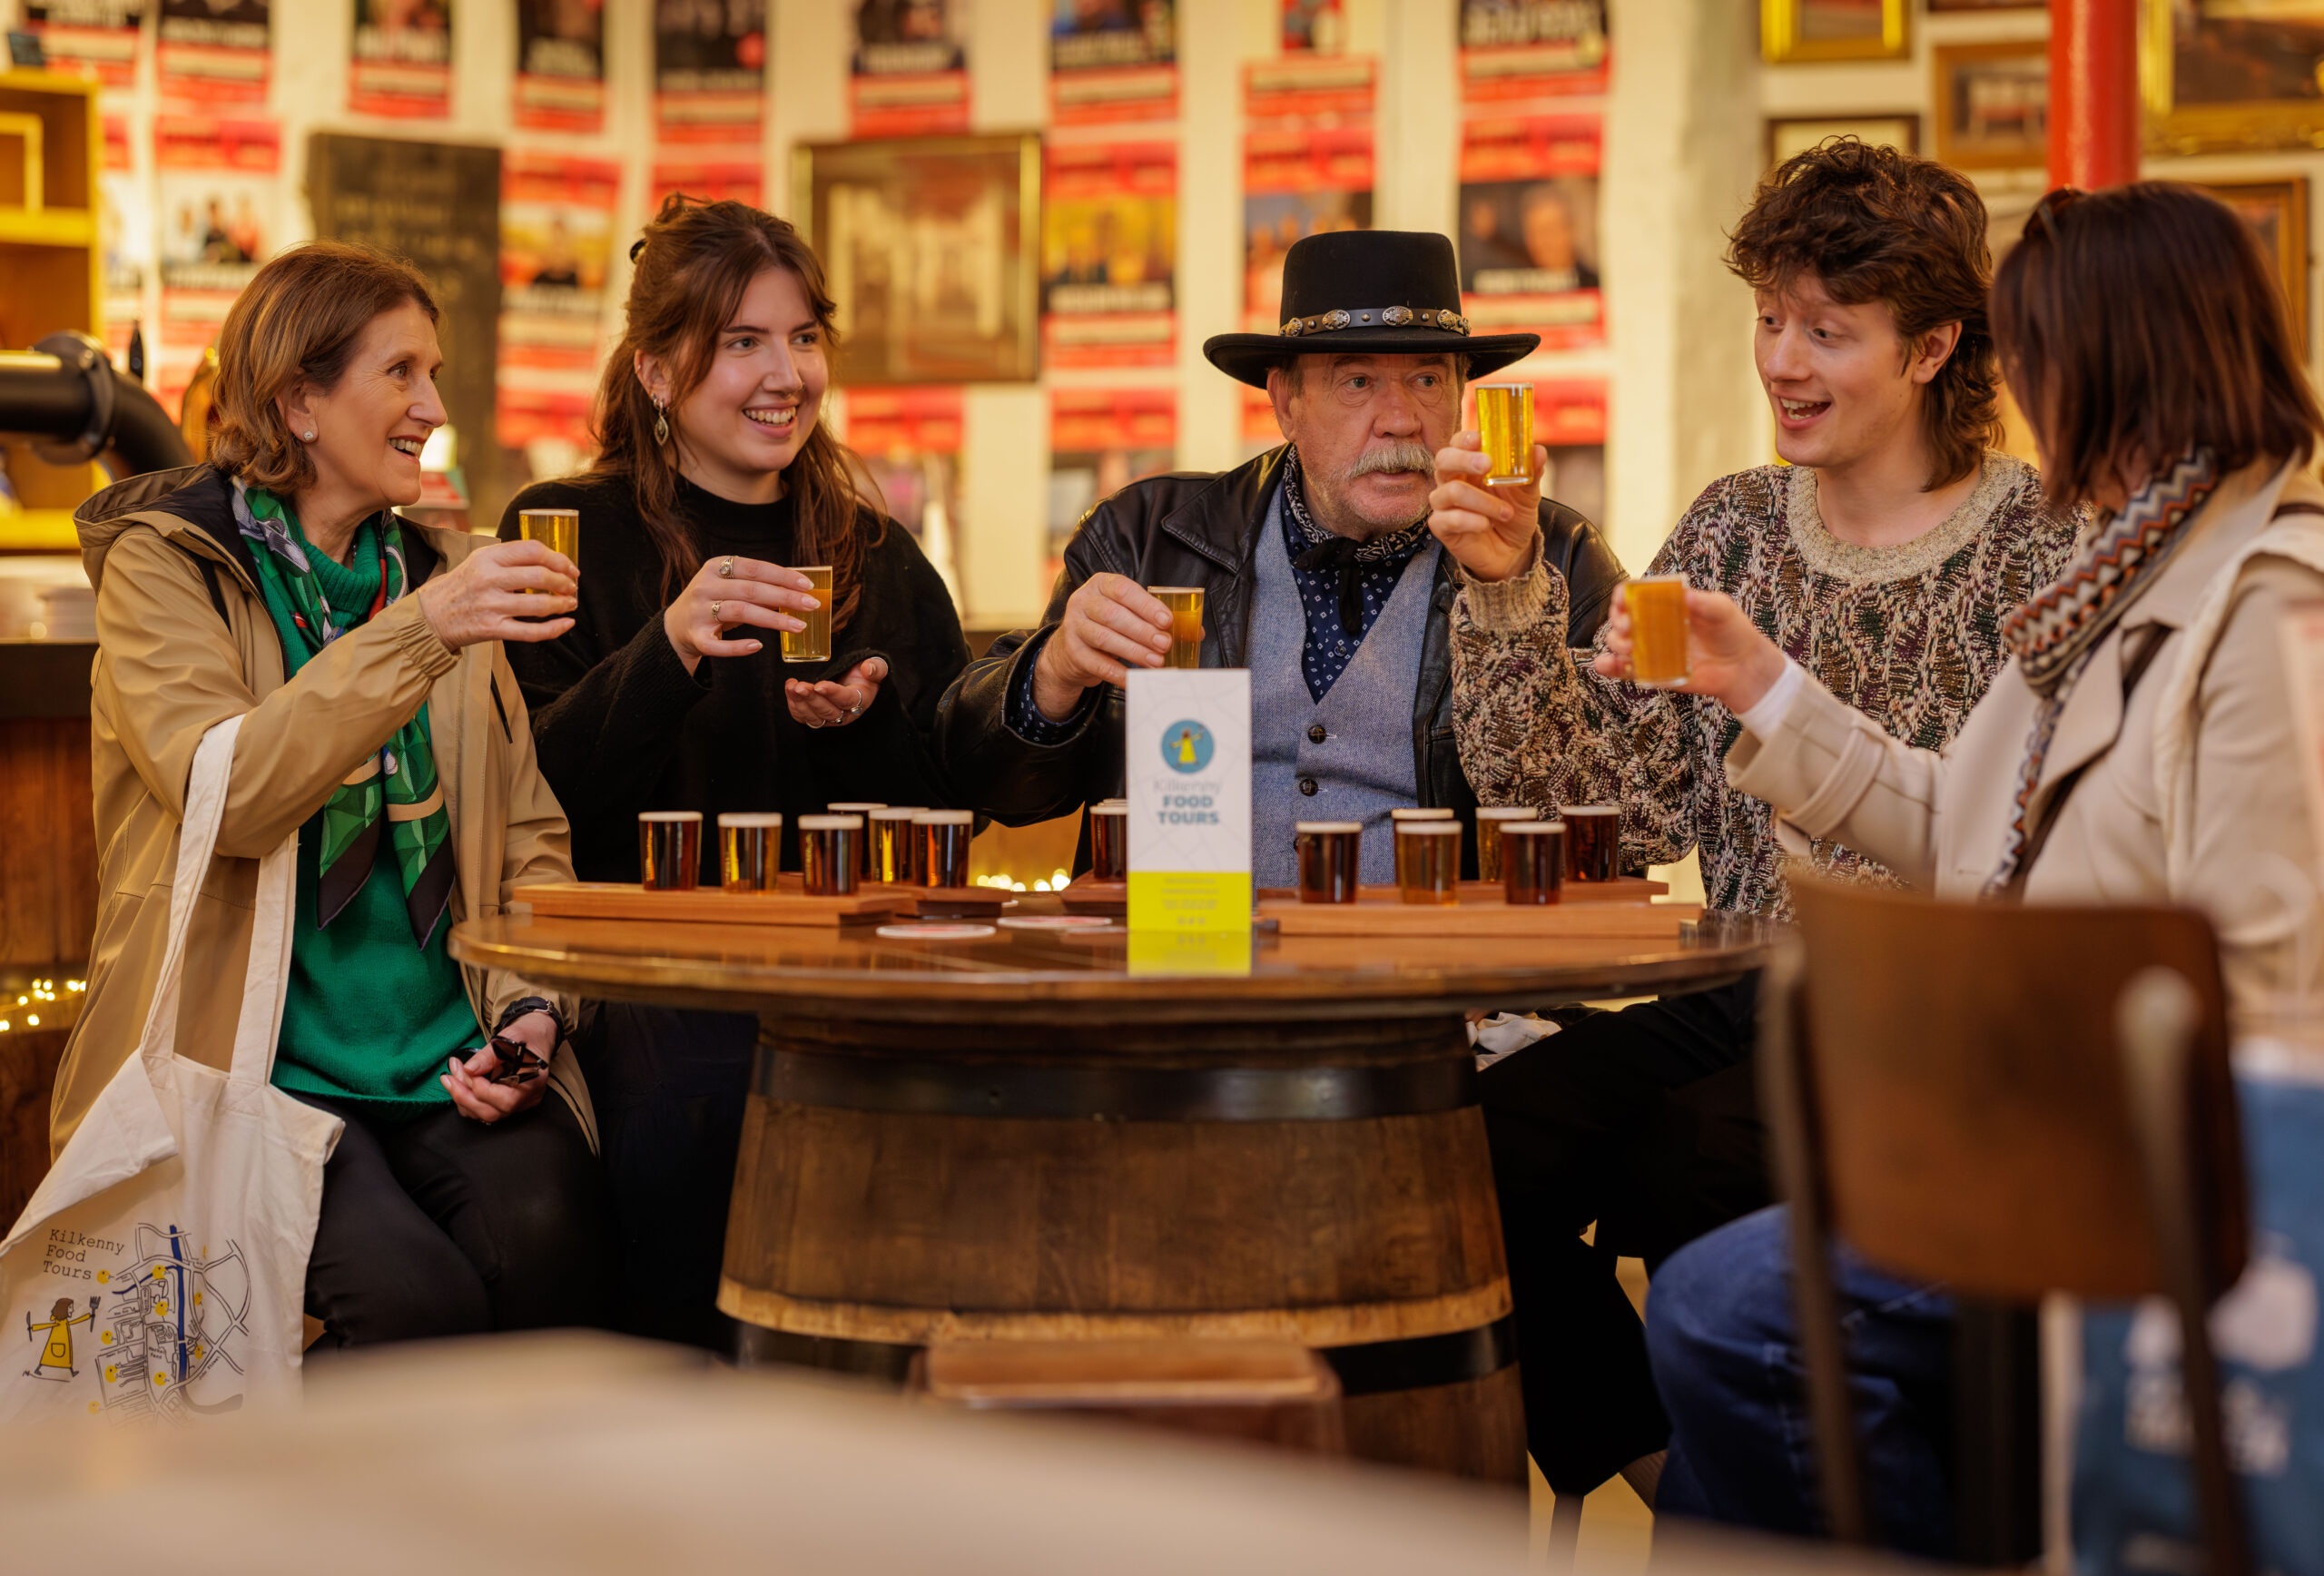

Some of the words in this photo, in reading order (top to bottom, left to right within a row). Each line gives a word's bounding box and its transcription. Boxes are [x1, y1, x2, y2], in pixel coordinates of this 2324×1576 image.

[1163, 795, 1213, 808] FOOD
[1157, 811, 1220, 825] TOURS
[49, 1228, 125, 1256] Kilkenny
[46, 1244, 86, 1263] Food
[44, 1260, 92, 1280] Tours
